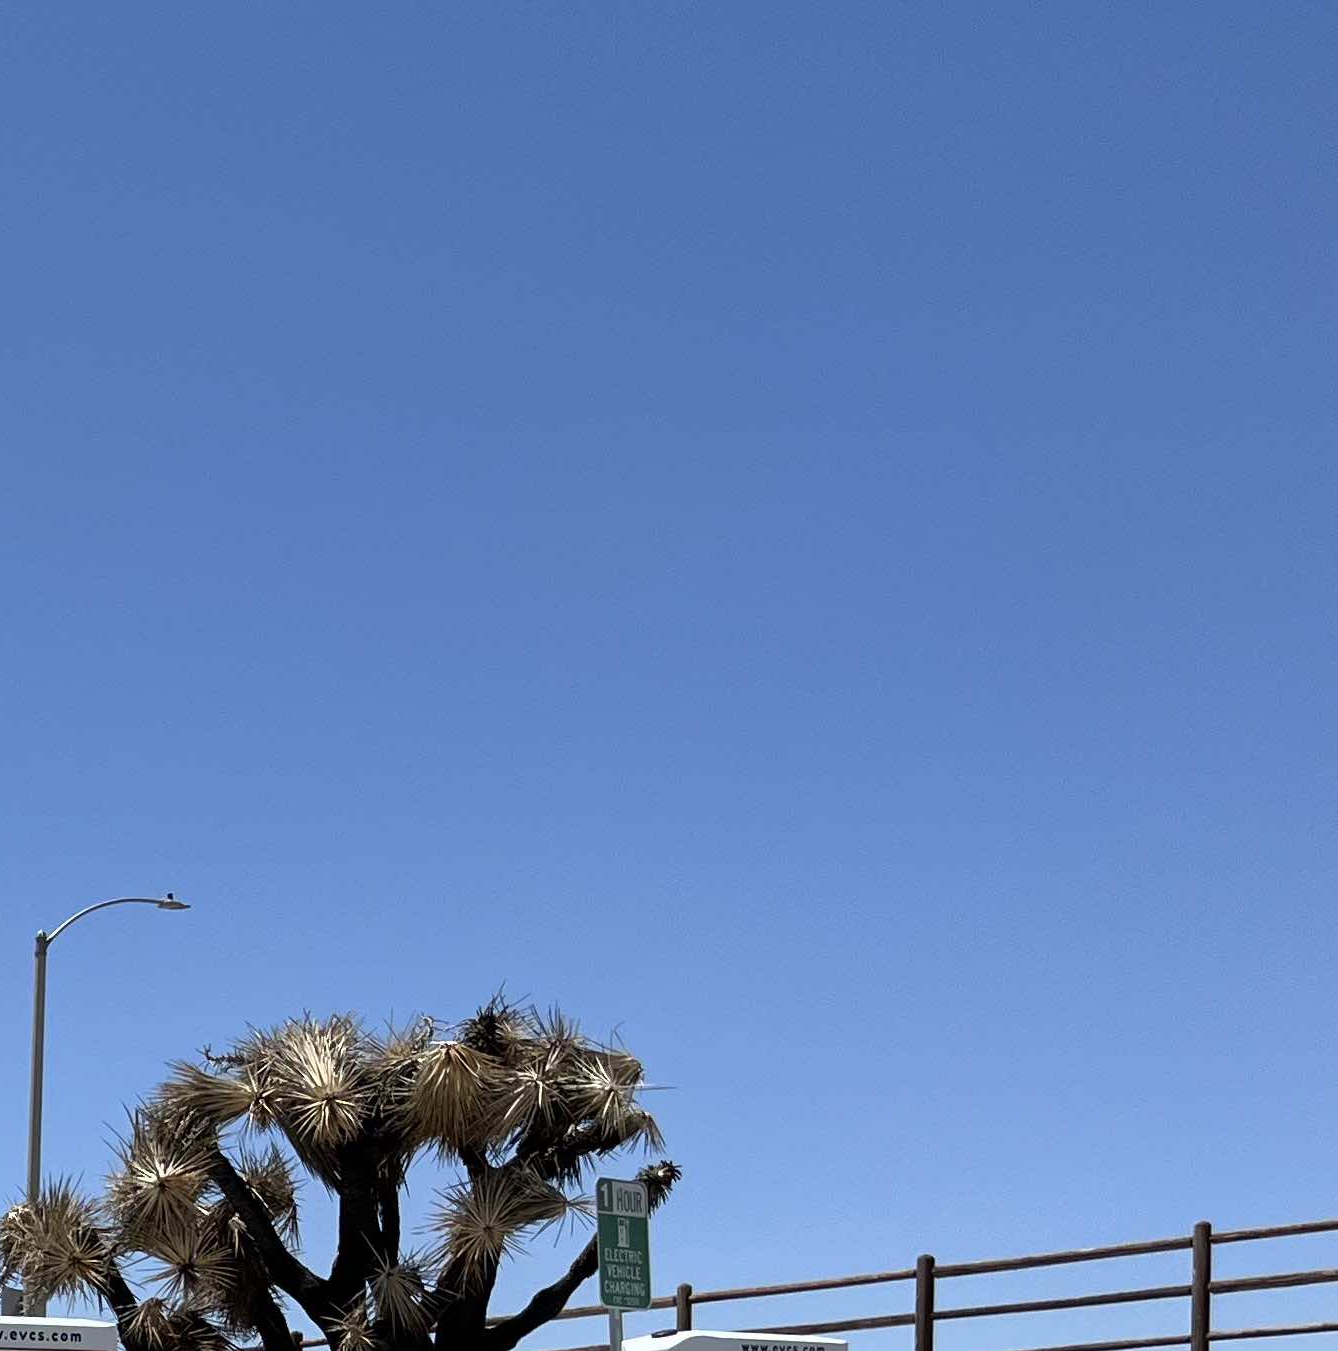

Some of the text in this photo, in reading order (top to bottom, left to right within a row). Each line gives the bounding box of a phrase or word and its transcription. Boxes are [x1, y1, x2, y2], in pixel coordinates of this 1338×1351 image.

[600, 1183, 643, 1213] 1 HOUR
[604, 1247, 643, 1265] ELECTRIC
[606, 1263, 642, 1281] VEHICLE
[603, 1279, 646, 1297] CHARGING
